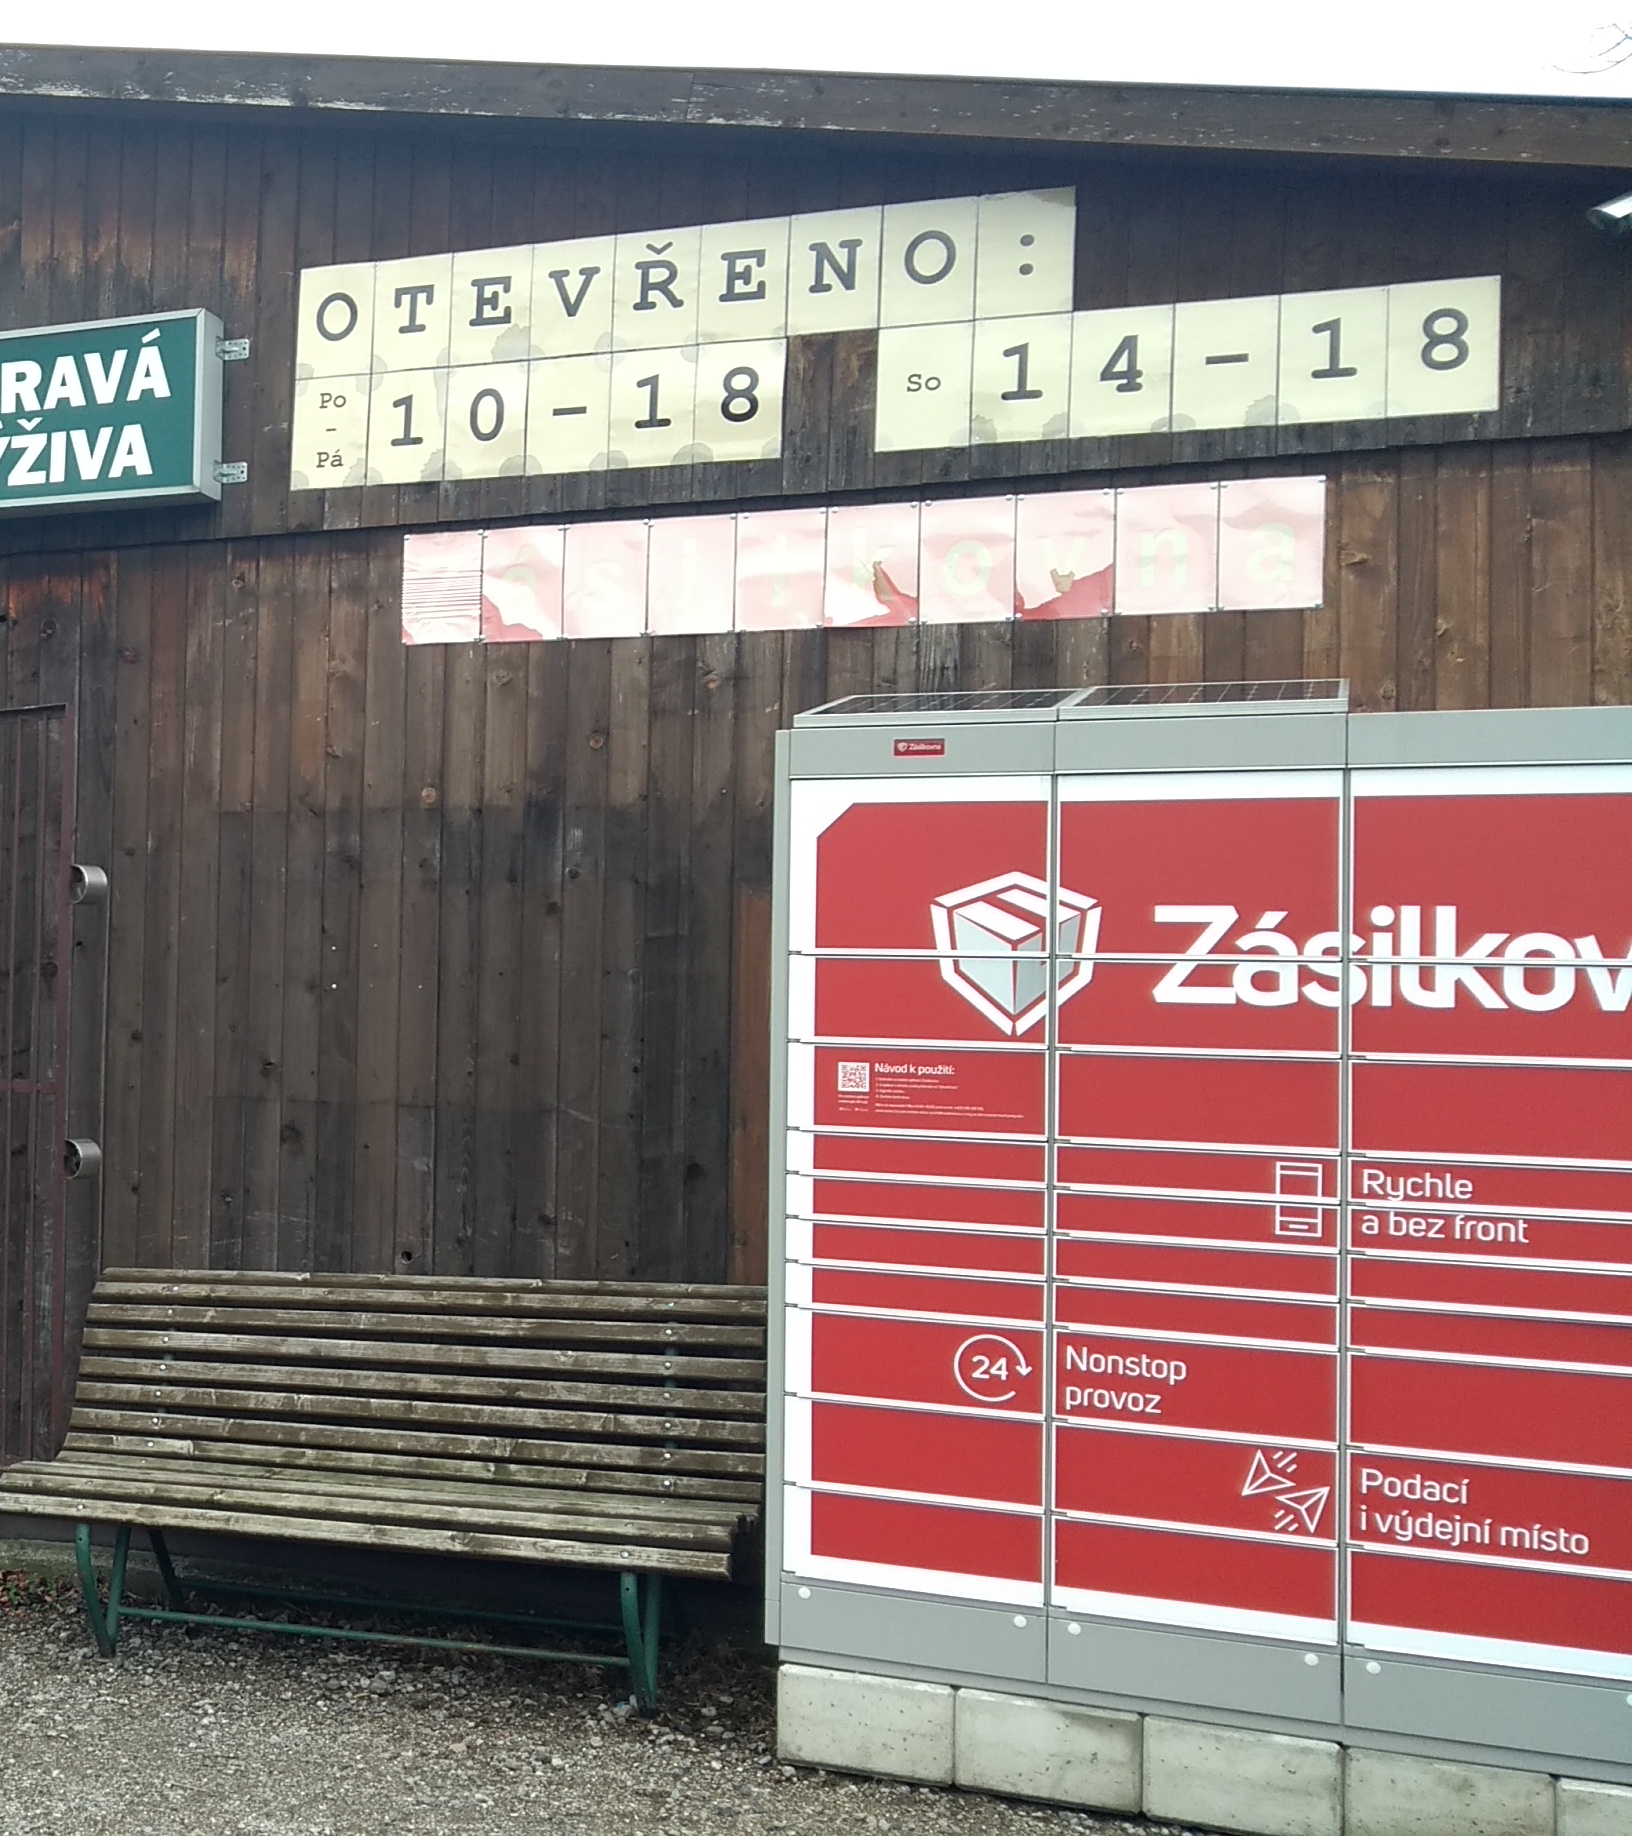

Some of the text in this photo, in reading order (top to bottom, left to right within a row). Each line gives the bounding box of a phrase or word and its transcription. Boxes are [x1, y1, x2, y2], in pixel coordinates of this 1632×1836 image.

[316, 229, 1035, 342] OTEVŘENO:
[906, 373, 942, 393] So
[319, 392, 347, 410] Po
[316, 449, 345, 469] Pá
[874, 1062, 956, 1077] Návod k použití:
[1362, 1168, 1473, 1201] Rychle
[1361, 1211, 1529, 1243] a bez front
[971, 1354, 1009, 1381] 24
[1065, 1345, 1187, 1385] Nonstop
[1065, 1386, 1162, 1414] provoz
[1361, 1468, 1470, 1504] Podací
[1360, 1505, 1589, 1555] i výdejní místo
